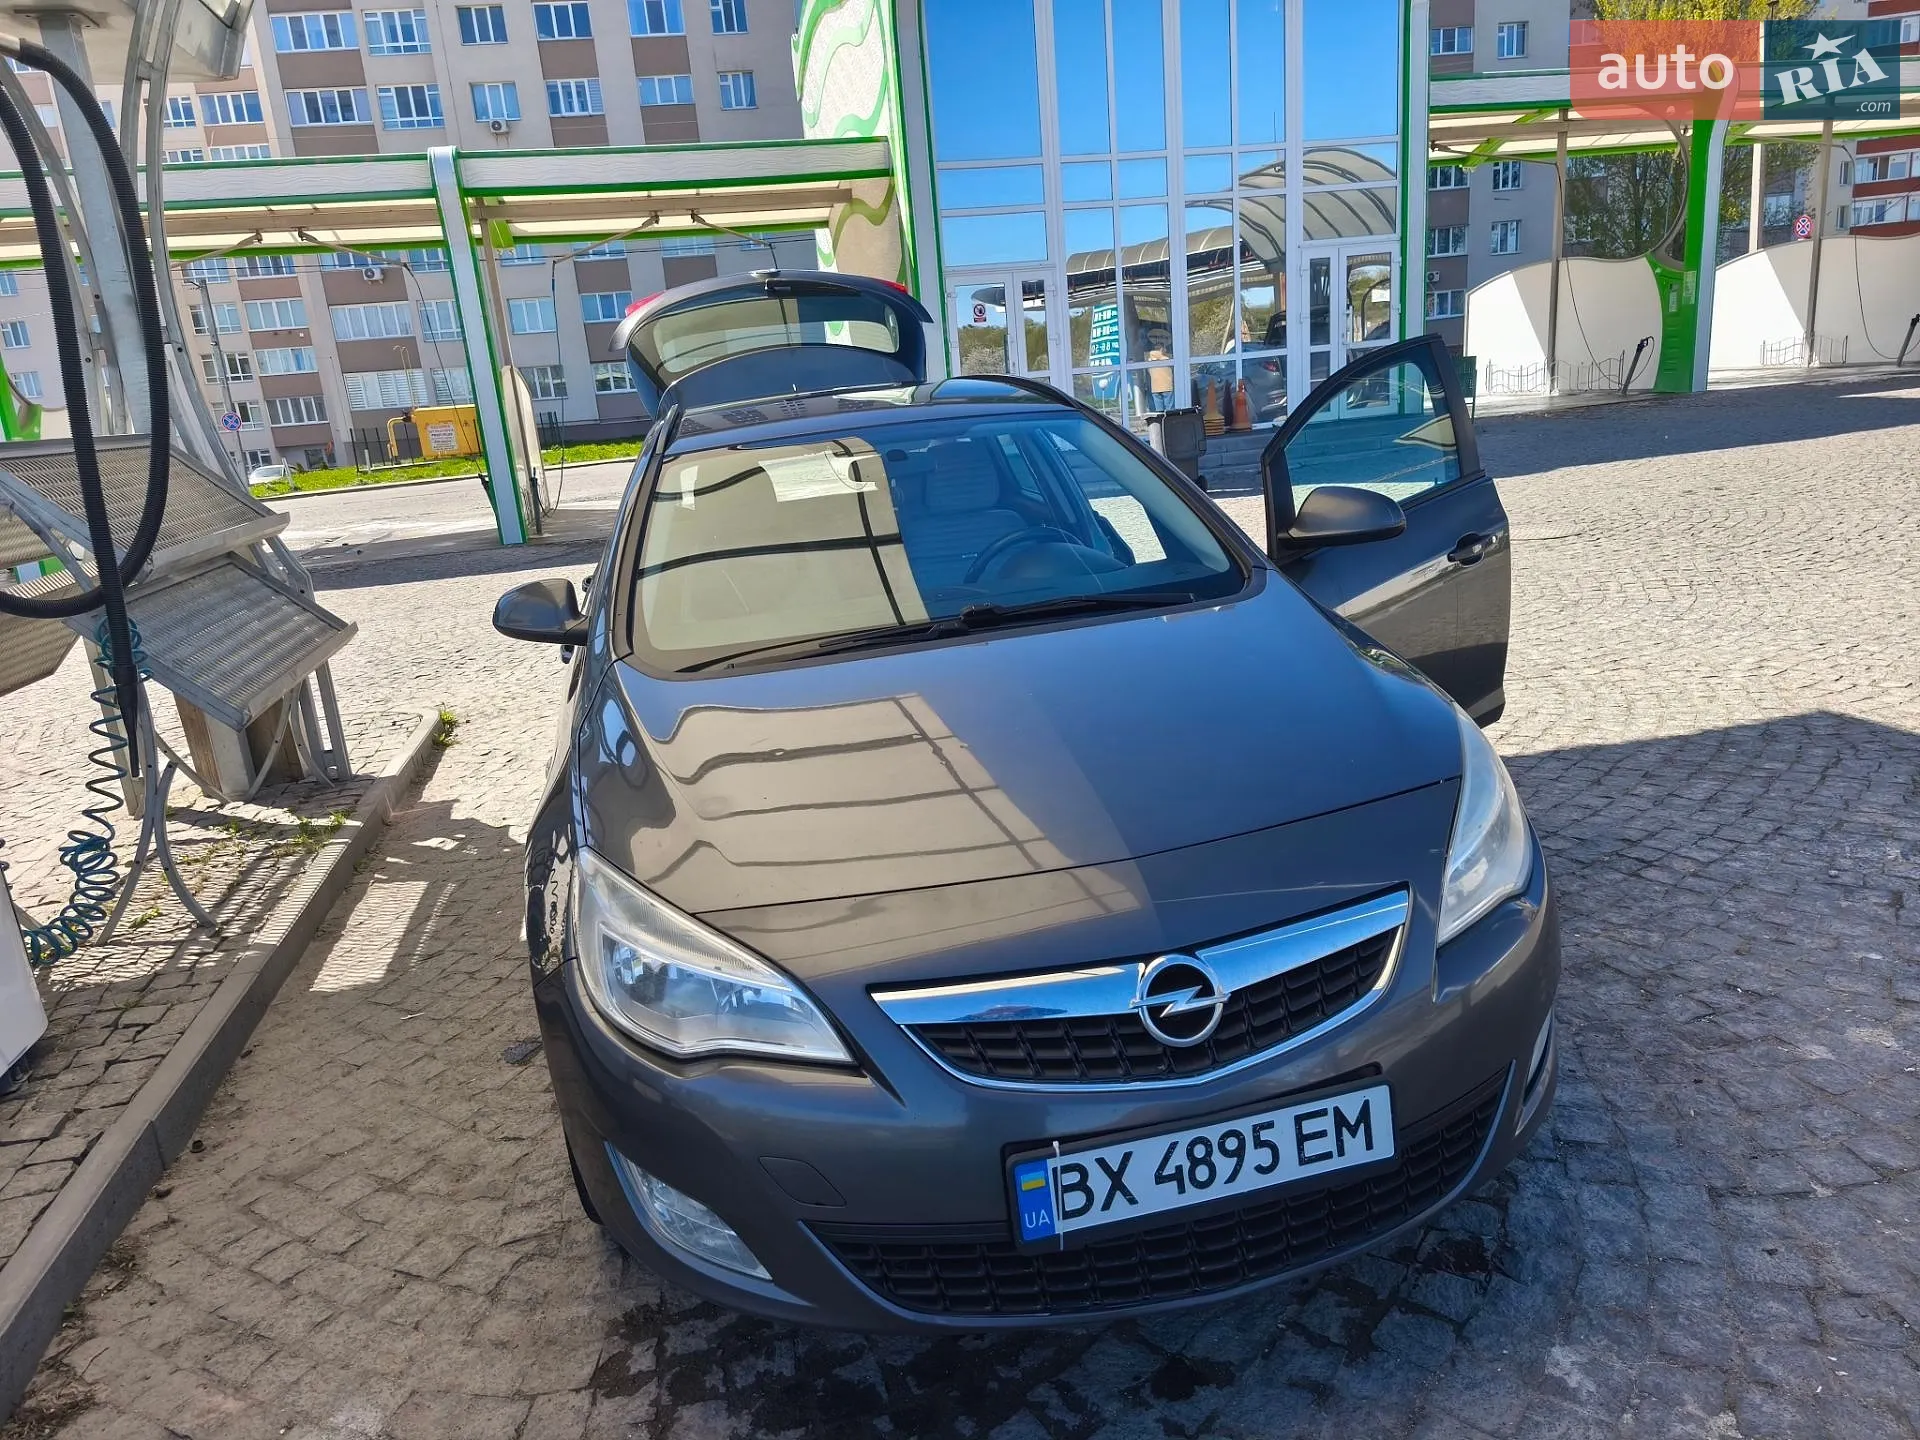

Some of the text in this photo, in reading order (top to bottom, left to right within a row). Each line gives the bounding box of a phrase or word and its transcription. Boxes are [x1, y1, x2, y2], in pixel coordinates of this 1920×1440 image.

[1053, 1099, 1374, 1221] BX 4895 EM
[1025, 1208, 1051, 1229] UA
